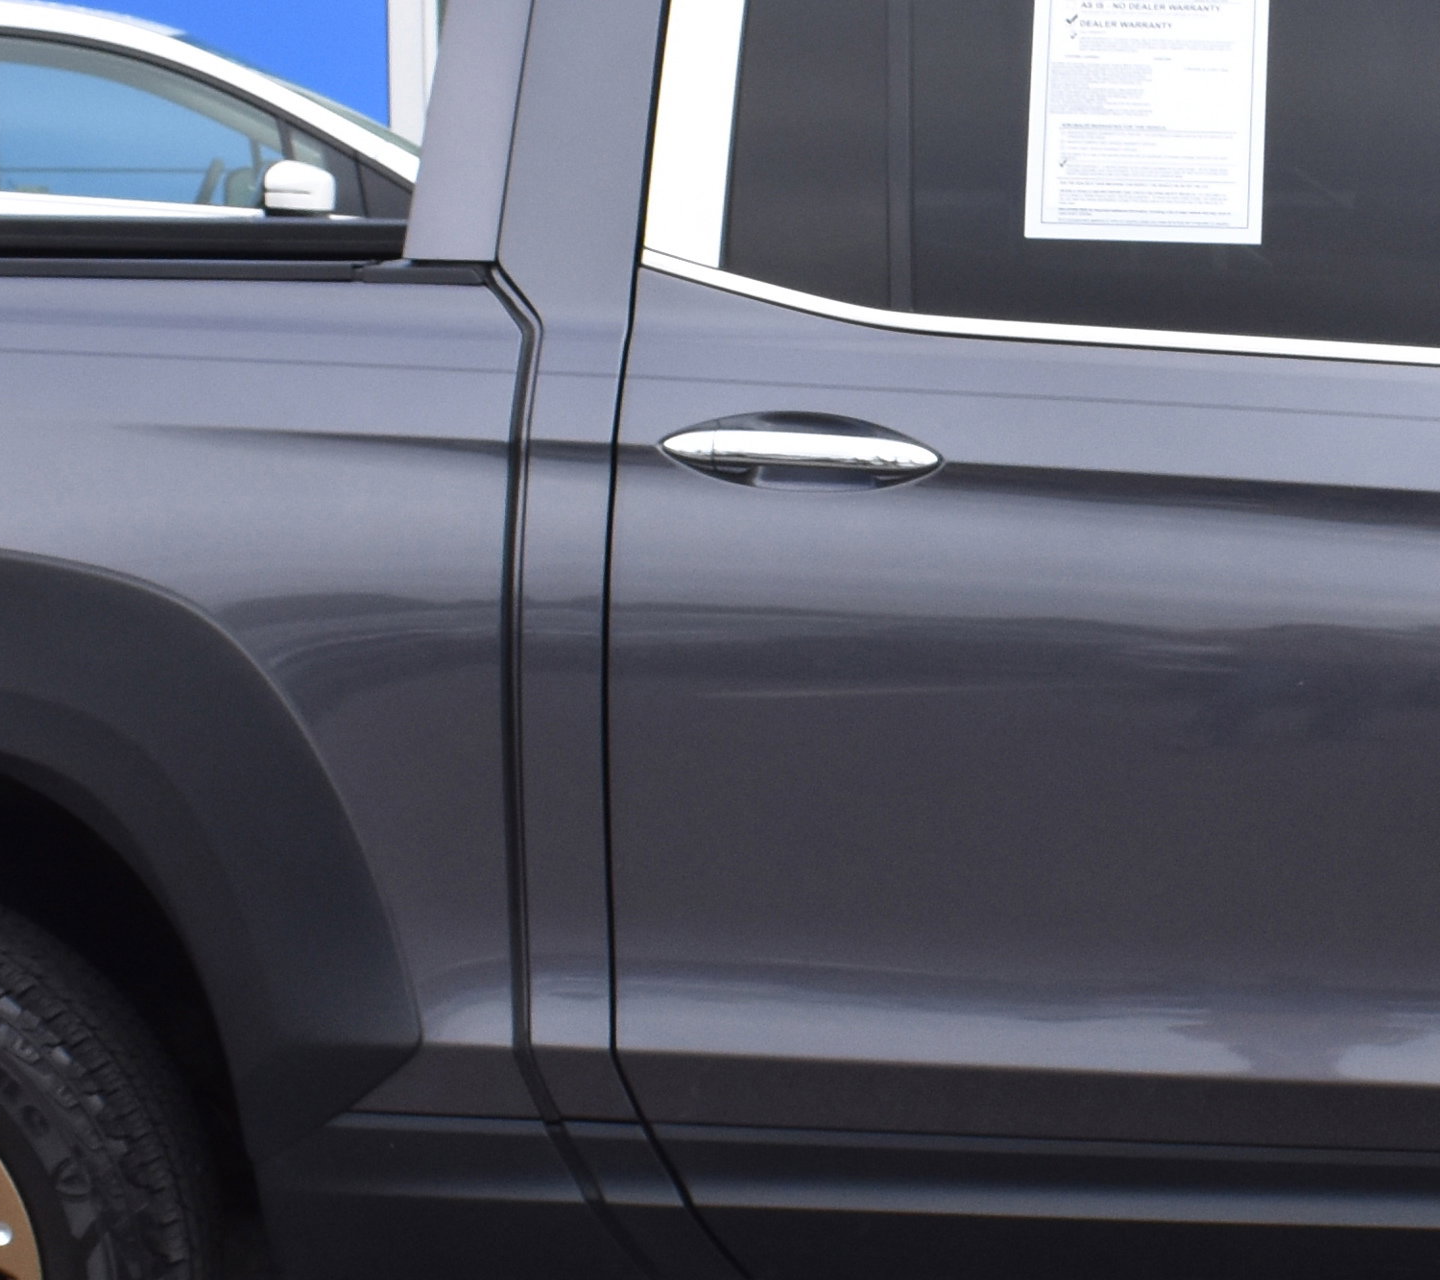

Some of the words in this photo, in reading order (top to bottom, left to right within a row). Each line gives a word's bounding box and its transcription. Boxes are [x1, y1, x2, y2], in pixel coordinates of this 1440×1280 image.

[1129, 3, 1166, 11] DEALER
[1169, 4, 1220, 12] WARRANTY
[1080, 20, 1117, 28] DEALER
[1120, 21, 1172, 30] WARRANTY
